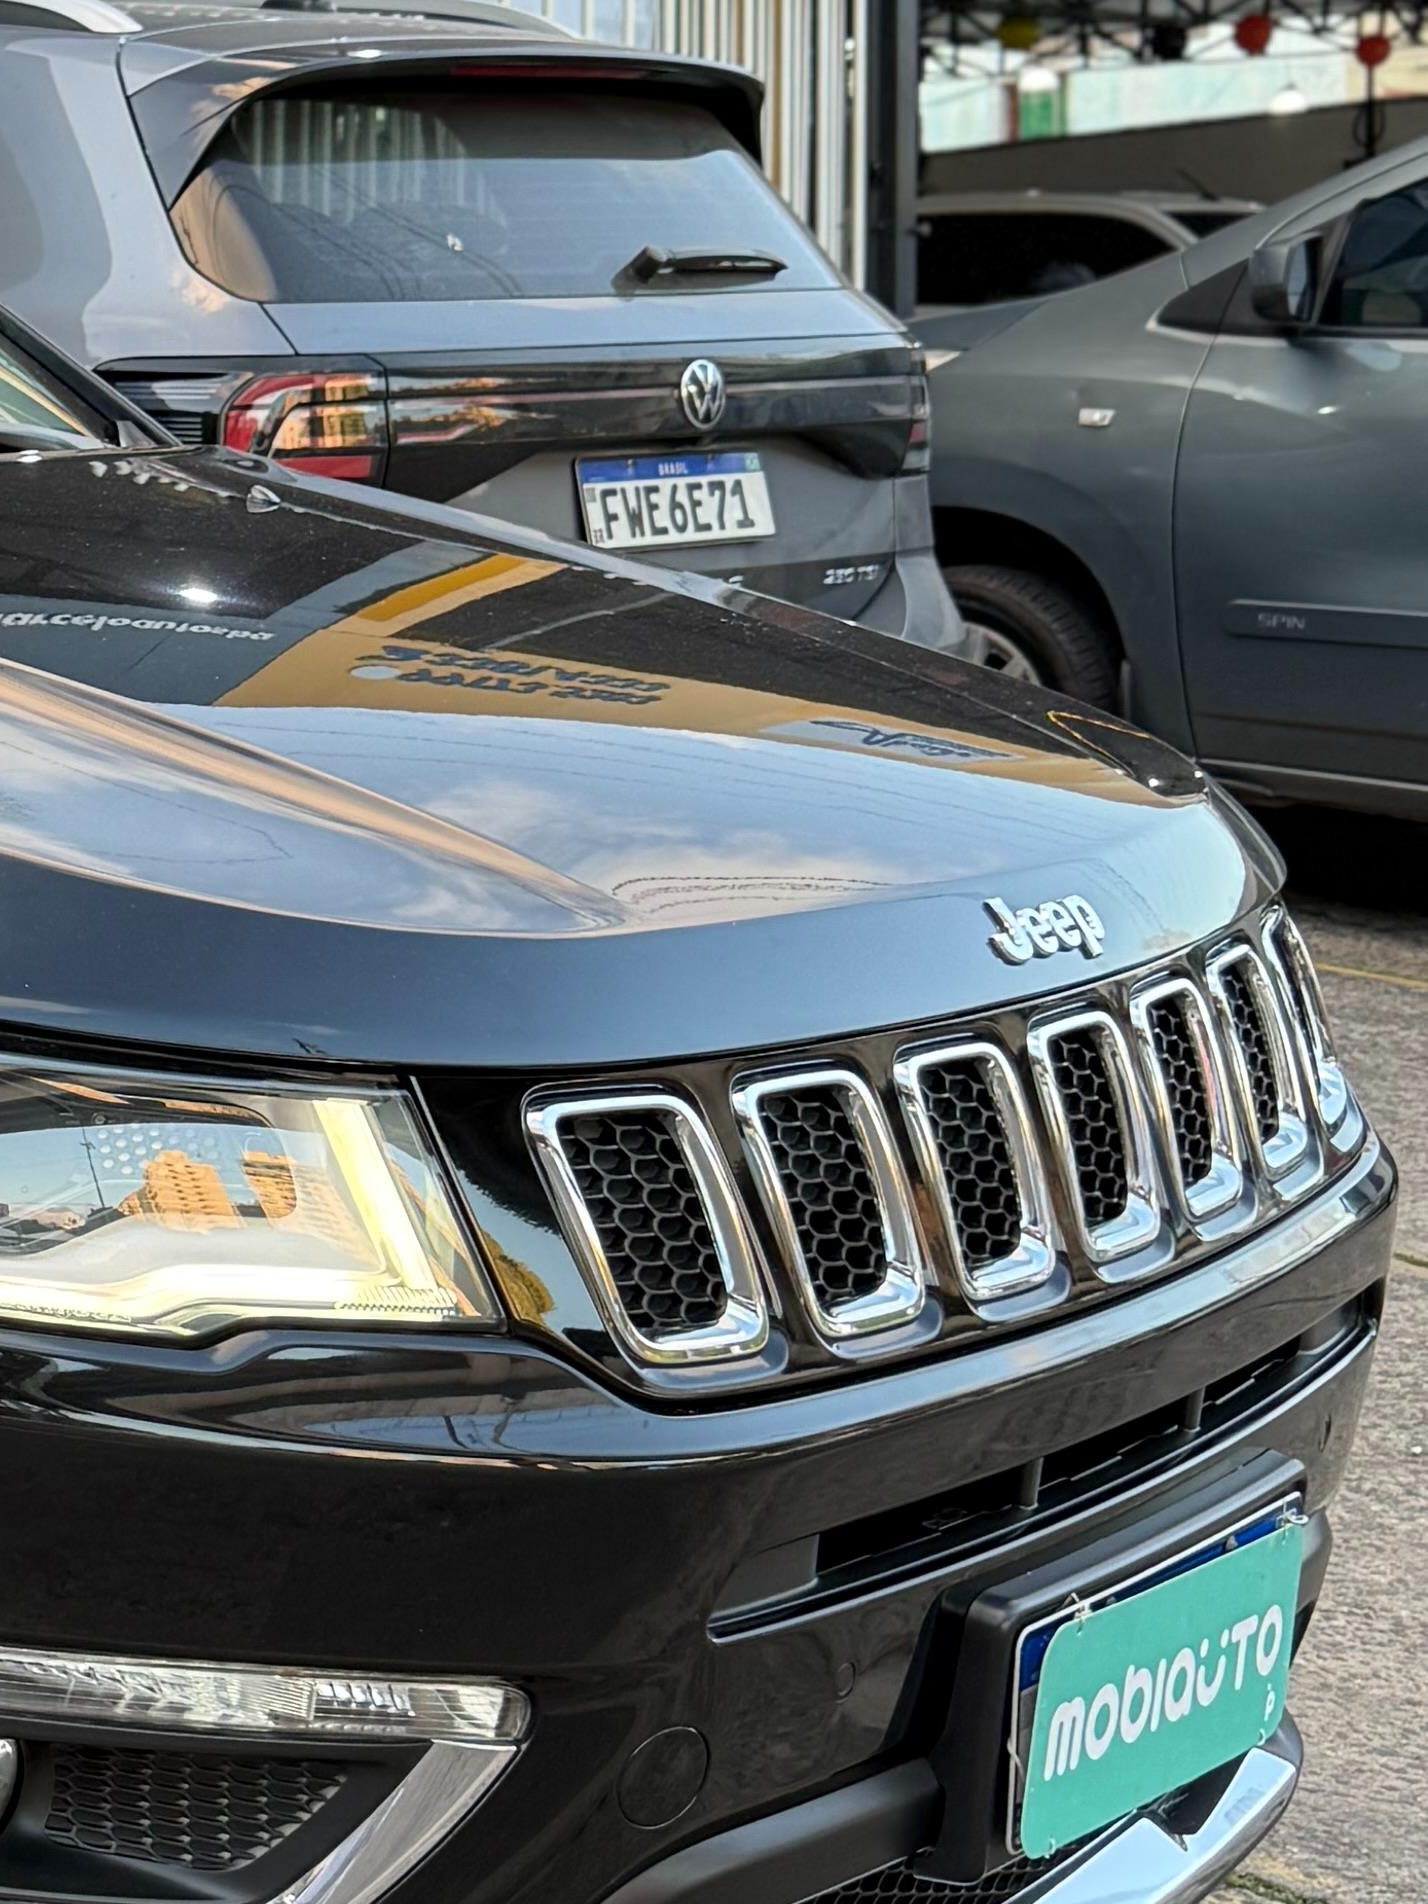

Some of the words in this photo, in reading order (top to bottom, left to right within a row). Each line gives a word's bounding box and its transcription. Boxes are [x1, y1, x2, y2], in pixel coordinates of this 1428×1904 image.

[658, 462, 689, 476] BRASIL
[599, 479, 755, 540] FWE6E71
[1258, 613, 1306, 630] SPIN
[982, 895, 1105, 966] Jeep
